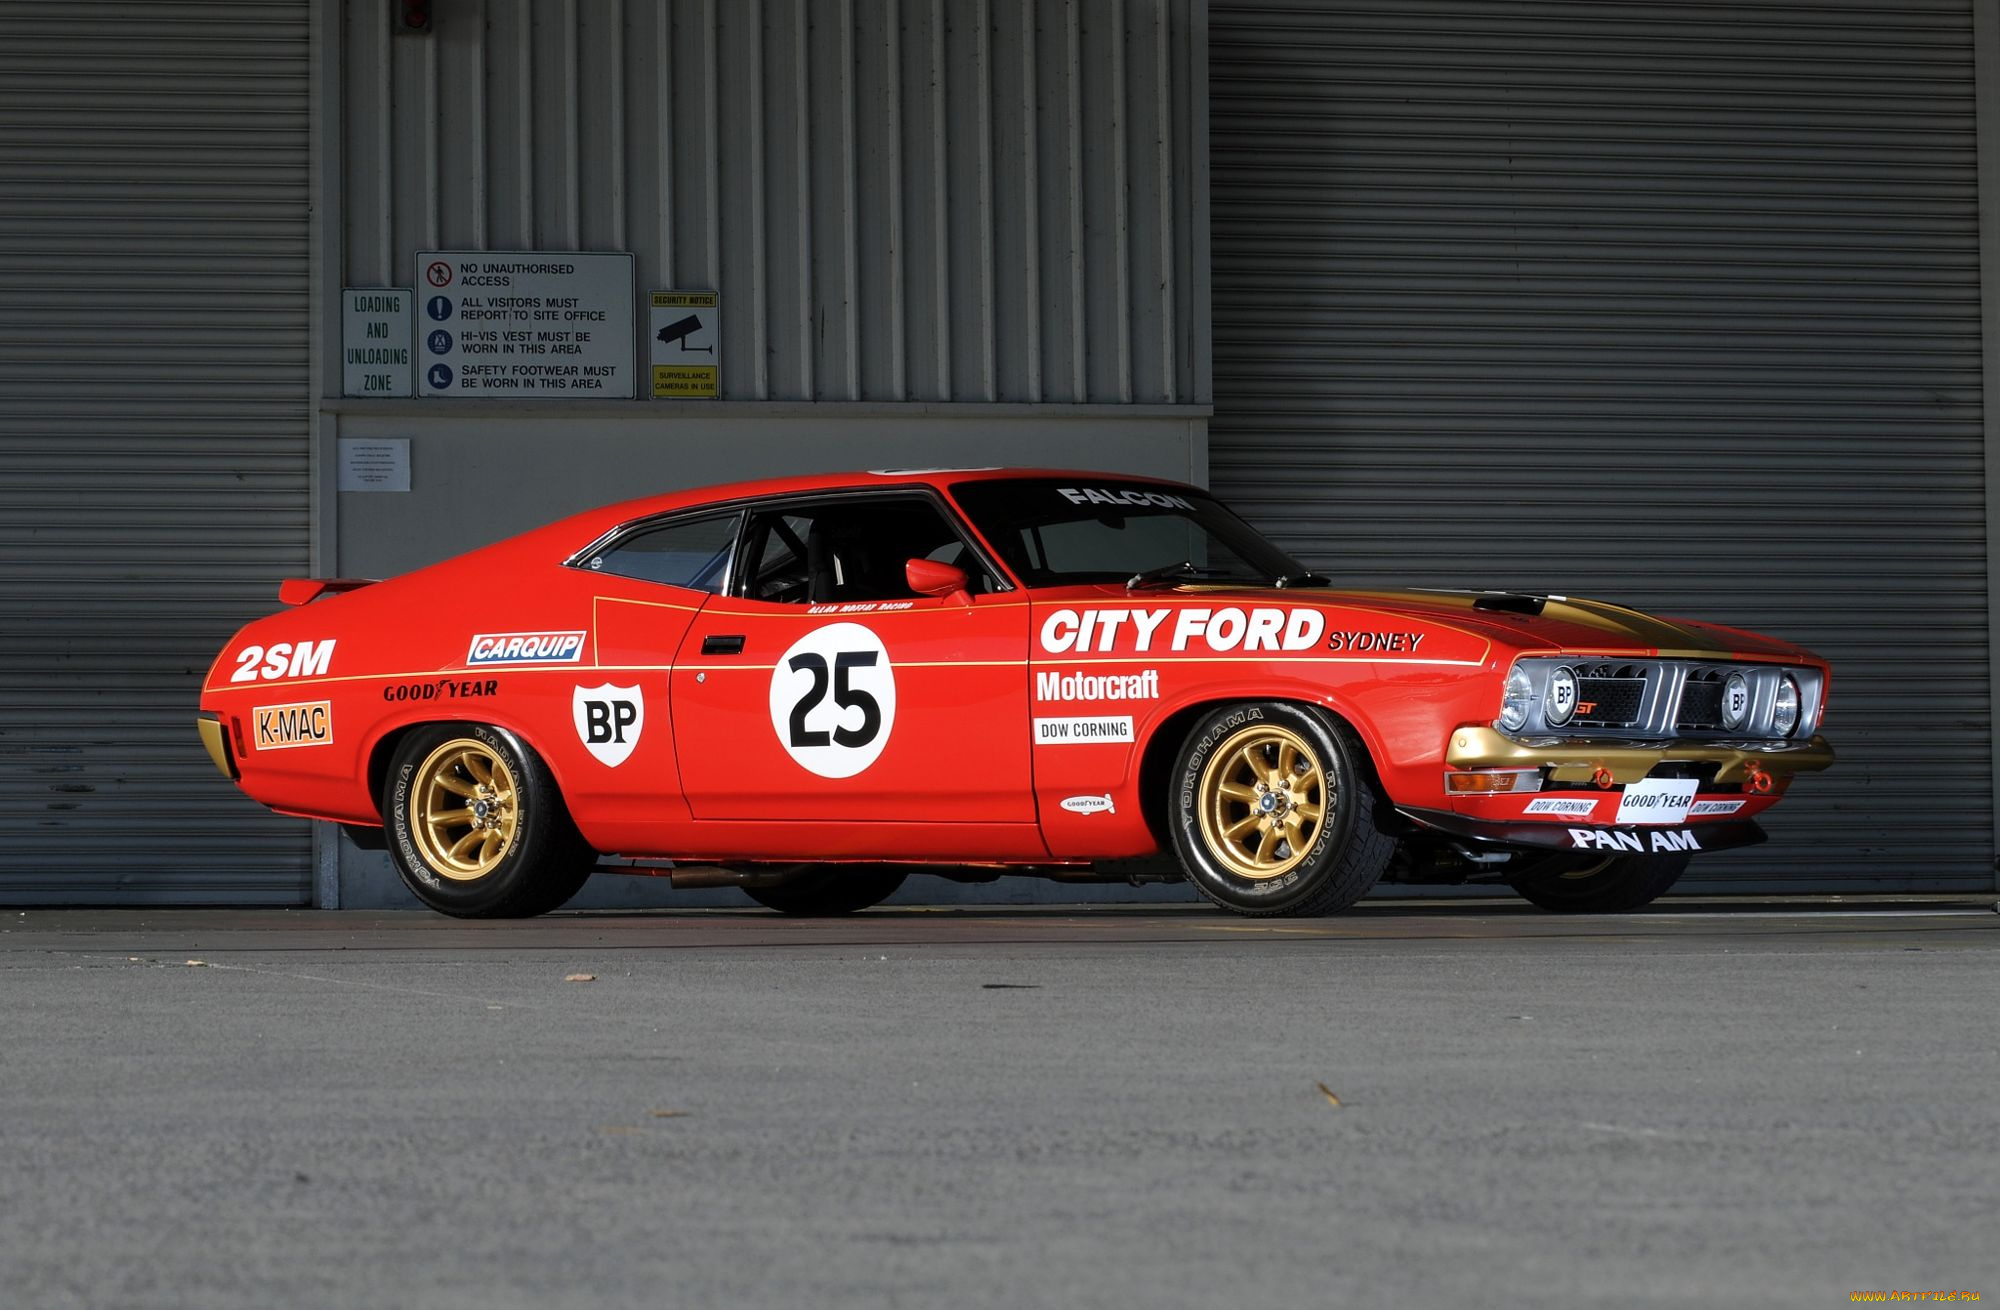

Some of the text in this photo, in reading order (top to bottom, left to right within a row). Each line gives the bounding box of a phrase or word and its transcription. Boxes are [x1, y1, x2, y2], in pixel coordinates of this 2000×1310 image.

[460, 264, 574, 274] NO UNAUTHORISED
[461, 276, 510, 286] ACCESS
[355, 296, 400, 312] LOADING
[461, 298, 579, 308] ALL VISITORS MUST
[654, 296, 714, 304] SECURITY NOTICE
[461, 310, 606, 321] REPORT TO SITE OFFICE
[366, 323, 389, 338] AND
[461, 331, 591, 342] HI-VIS VEST MUST BE
[347, 349, 408, 364] UNLOADING
[462, 344, 582, 354] WORN IN THIS AREA
[461, 366, 616, 376] SAFETY FOOTWEAR MUST
[659, 372, 711, 380] SURVEILLANCE
[364, 375, 392, 390] ZONE
[461, 378, 602, 389] BE WORN IN THIS AREA
[1056, 488, 1197, 511] FALCON
[807, 602, 914, 614] ALLAN MOFFAT RACING
[1040, 608, 1424, 653] CITY FORD SYDNEY
[473, 635, 580, 660] CARQUIP
[230, 639, 337, 683] 2SM
[1036, 669, 1159, 702] Motorcraft
[788, 651, 881, 748] 25
[1557, 686, 1572, 704] BP
[1731, 693, 1745, 712] BP
[1576, 702, 1597, 714] GT
[259, 706, 326, 744] K-MAC
[583, 701, 637, 744] BP
[1041, 722, 1128, 738] DOW CORNING
[1181, 707, 1264, 831] YOKOHAMA
[1530, 801, 1593, 813] DOW CORNING
[1301, 770, 1338, 867] RADIAL
[394, 763, 441, 890] YOKOHAMA
[1567, 828, 1702, 853] PAN AM
